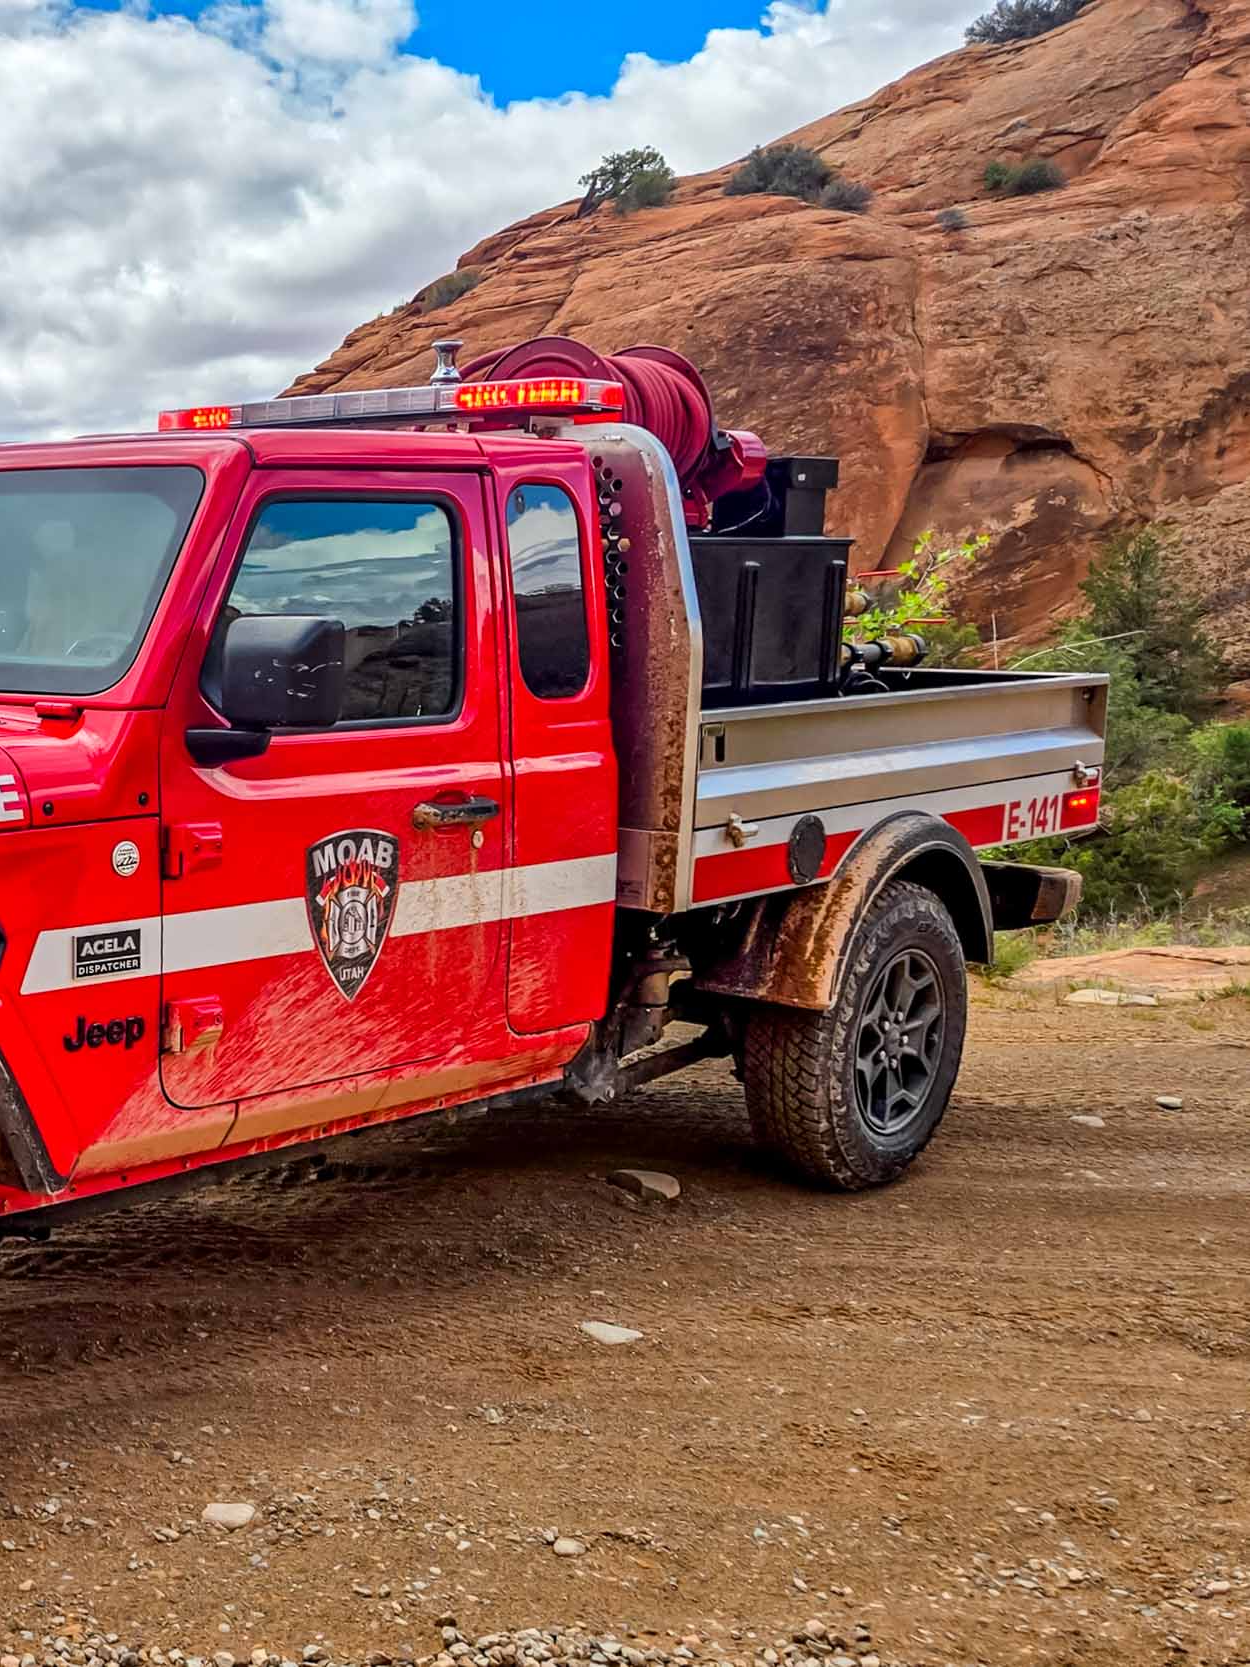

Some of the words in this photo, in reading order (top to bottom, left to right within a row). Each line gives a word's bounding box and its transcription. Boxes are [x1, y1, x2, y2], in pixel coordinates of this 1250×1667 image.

[1007, 794, 1059, 840] E-141
[312, 838, 394, 877] MOAB
[80, 935, 137, 957] ACELA
[77, 959, 139, 976] DISPATCHER
[339, 965, 364, 981] UTAH
[63, 1014, 145, 1052] Jeep
